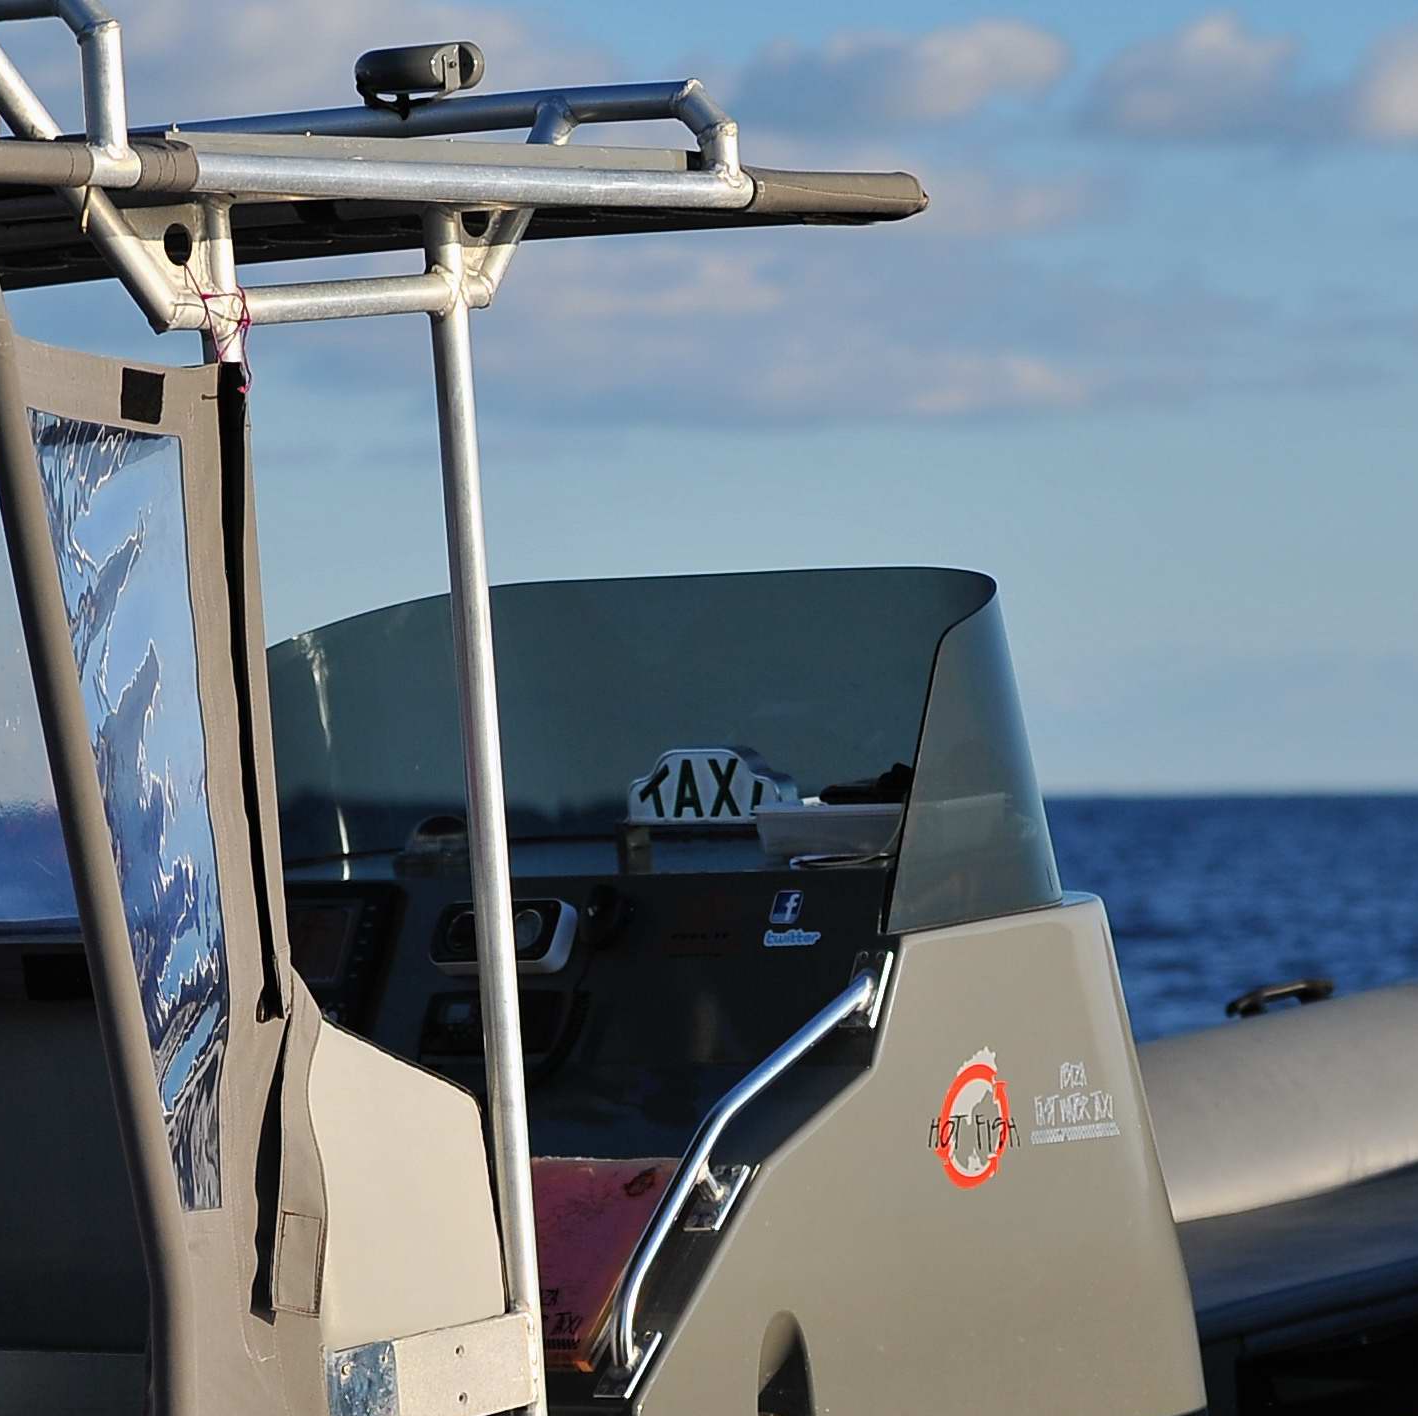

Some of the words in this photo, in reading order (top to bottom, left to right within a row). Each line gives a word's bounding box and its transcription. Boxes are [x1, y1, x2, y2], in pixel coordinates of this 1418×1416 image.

[765, 930, 821, 946] twitter
[928, 1114, 968, 1151] HOT
[975, 1113, 1021, 1153] FISH
